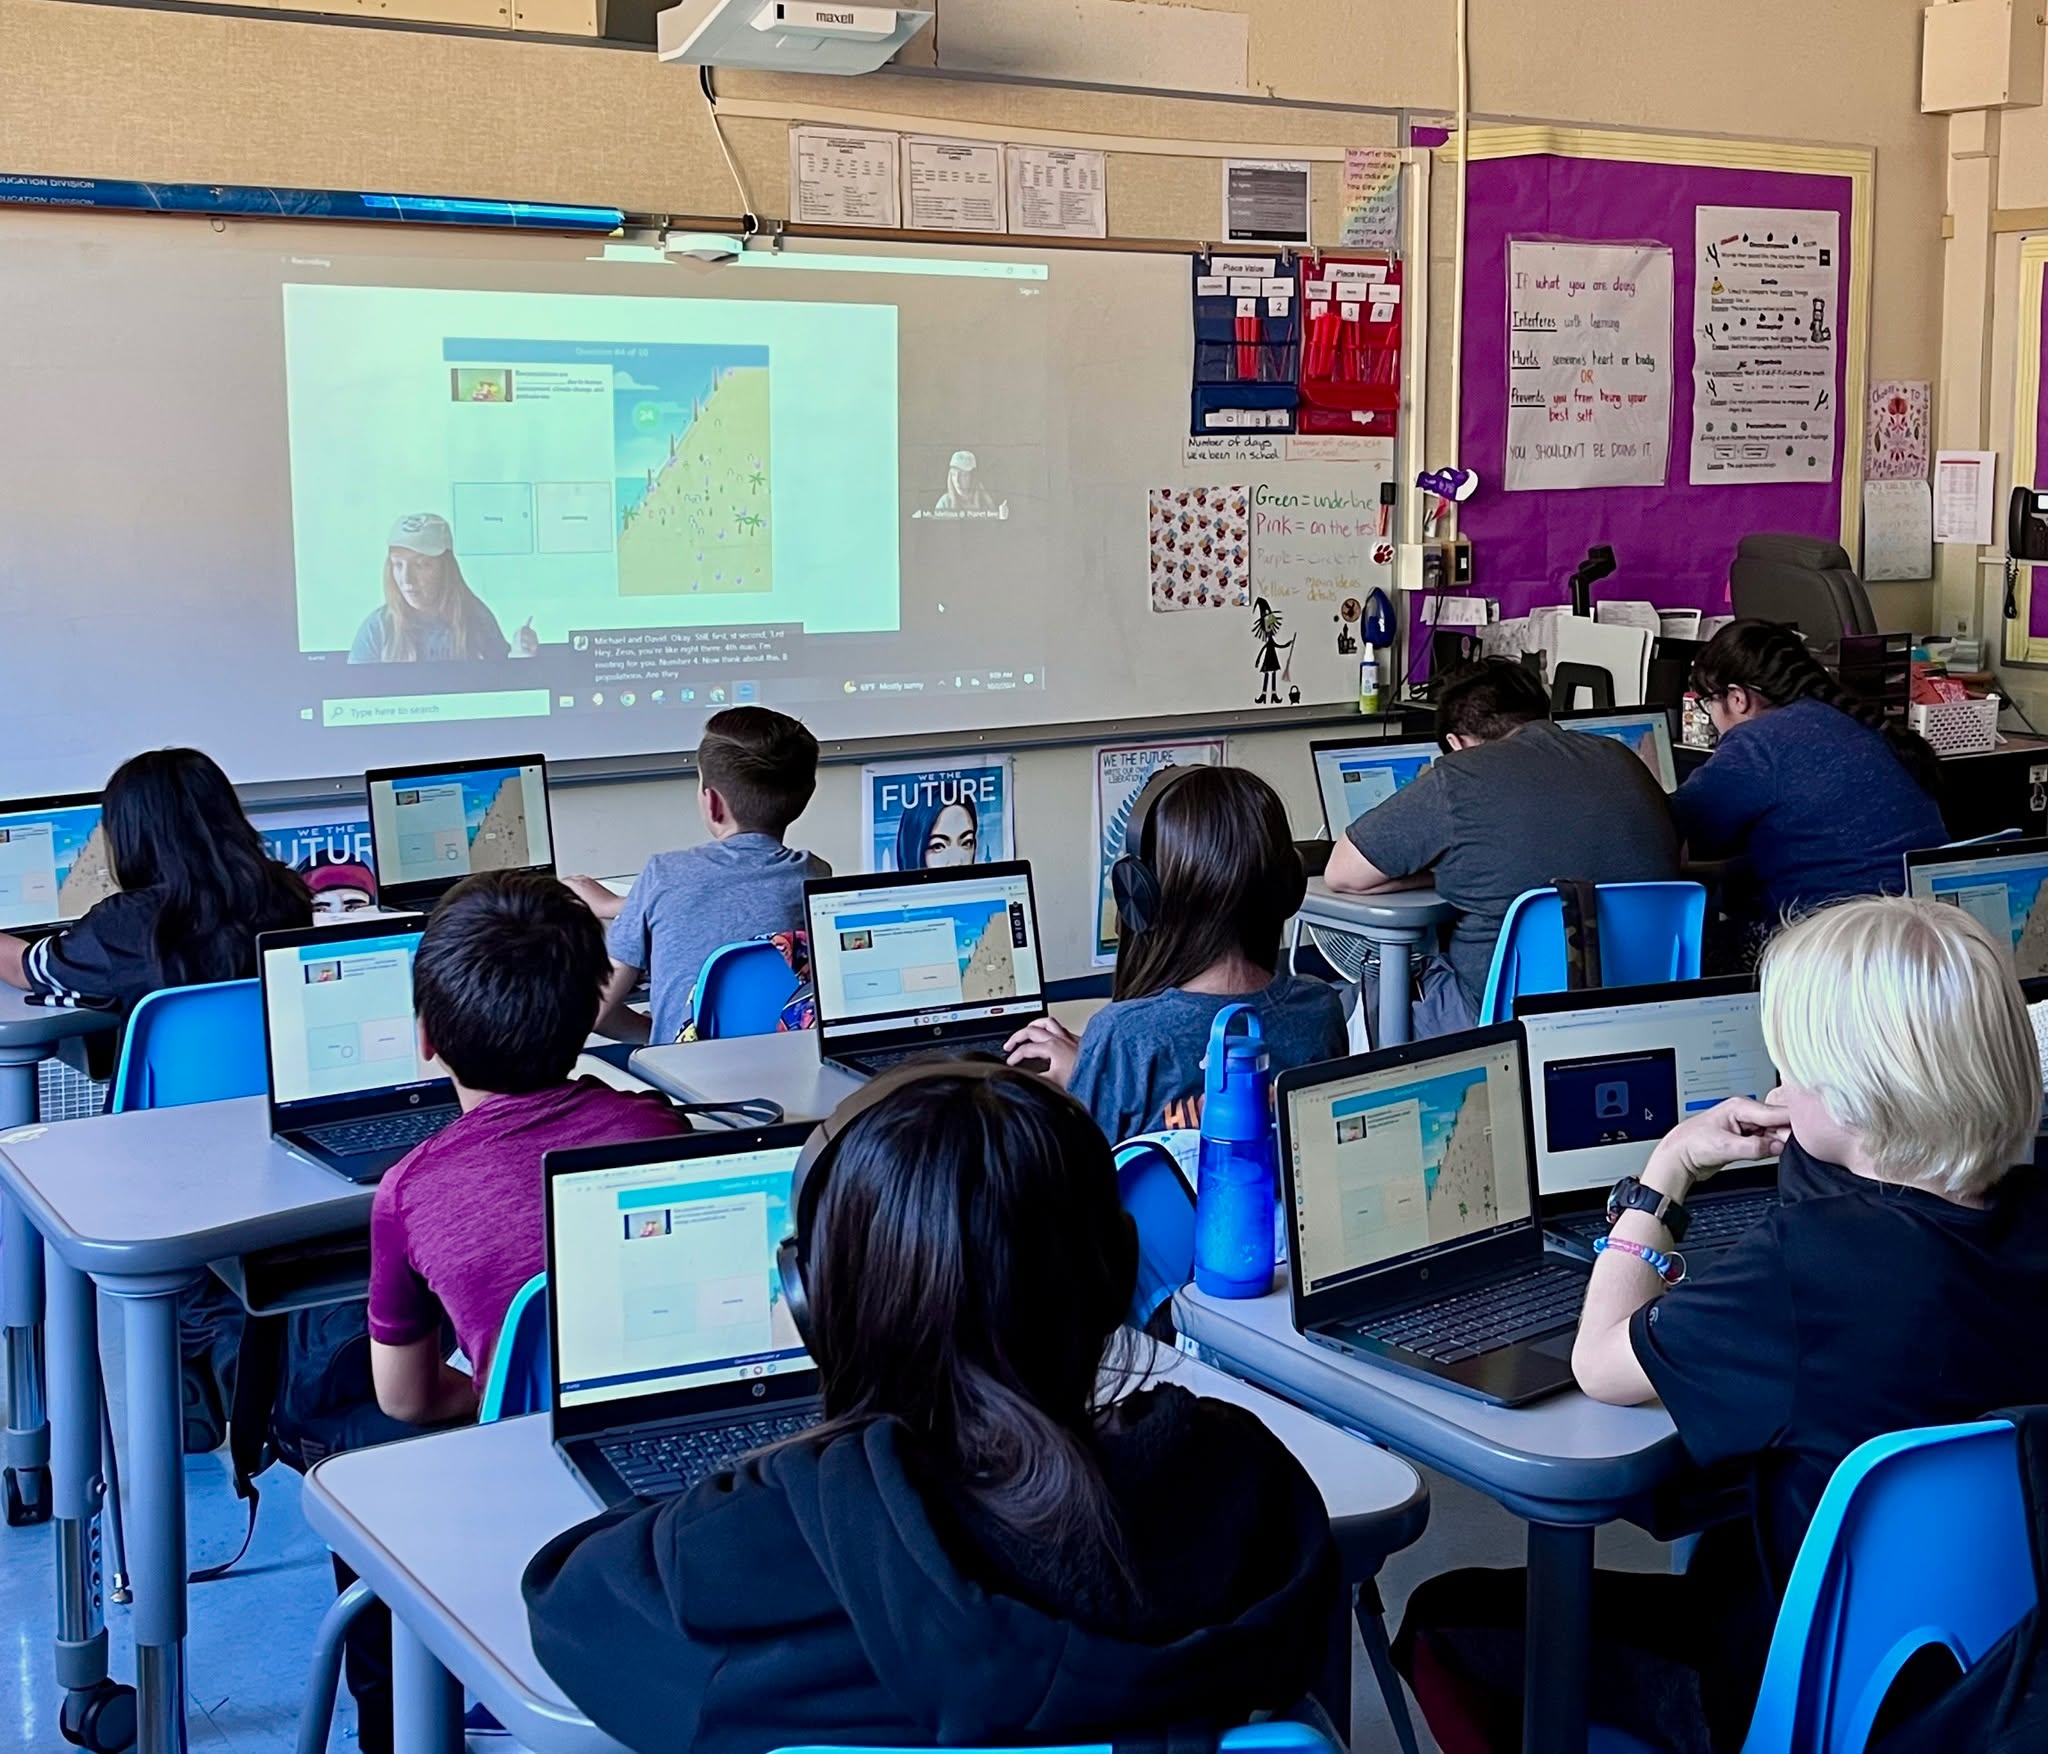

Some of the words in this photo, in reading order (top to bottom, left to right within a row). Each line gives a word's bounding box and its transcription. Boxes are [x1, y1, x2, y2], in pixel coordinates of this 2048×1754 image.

[816, 12, 854, 24] maxell
[50, 179, 95, 189] DIVISION
[50, 197, 95, 206] DIVISION
[1223, 263, 1243, 272] Place
[1245, 263, 1265, 273] Value
[1336, 269, 1355, 277] Place
[1357, 271, 1376, 279] Value
[1536, 278, 1561, 290] what
[1569, 280, 1586, 298] you
[1593, 281, 1608, 290] are
[1613, 276, 1636, 298] doing
[1243, 303, 1249, 312] 4
[1276, 302, 1282, 312] 2
[1347, 307, 1353, 317] 3
[1512, 311, 1557, 329] Interferes
[1564, 316, 1582, 329] with
[1512, 350, 1540, 366] Hurts
[1592, 350, 1614, 366] heart
[1621, 355, 1630, 366] or
[1635, 351, 1656, 372] body
[1580, 369, 1595, 384] OR
[1511, 388, 1546, 404] Prevents
[1553, 393, 1568, 409] you
[1574, 388, 1594, 404] from
[1599, 388, 1622, 409] being
[1627, 393, 1648, 409] your
[1549, 408, 1569, 423] best
[1577, 408, 1594, 422] self
[1188, 437, 1224, 447] Number
[1228, 435, 1241, 447] of
[1244, 436, 1272, 451] days
[1236, 451, 1247, 460] in
[1249, 447, 1280, 460] school
[1509, 446, 1527, 461] YOU
[1593, 443, 1606, 459] BE
[1256, 484, 1299, 507] Green
[1256, 512, 1293, 537] Pink
[1310, 521, 1326, 535] on
[1329, 518, 1353, 538] the
[627, 635, 643, 644] and
[701, 656, 720, 665] Now
[351, 708, 373, 720] Type
[375, 706, 395, 717] here
[398, 705, 409, 715] to
[410, 704, 440, 715] search
[1103, 754, 1118, 768] WE
[1120, 752, 1138, 767] THE
[1140, 749, 1175, 765] FUTURE
[939, 771, 962, 780] THE
[1122, 767, 1136, 775] OUR
[882, 776, 996, 812] FUTURE
[297, 827, 320, 837] WE
[325, 824, 356, 834] THE
[258, 833, 372, 869] UTUR
